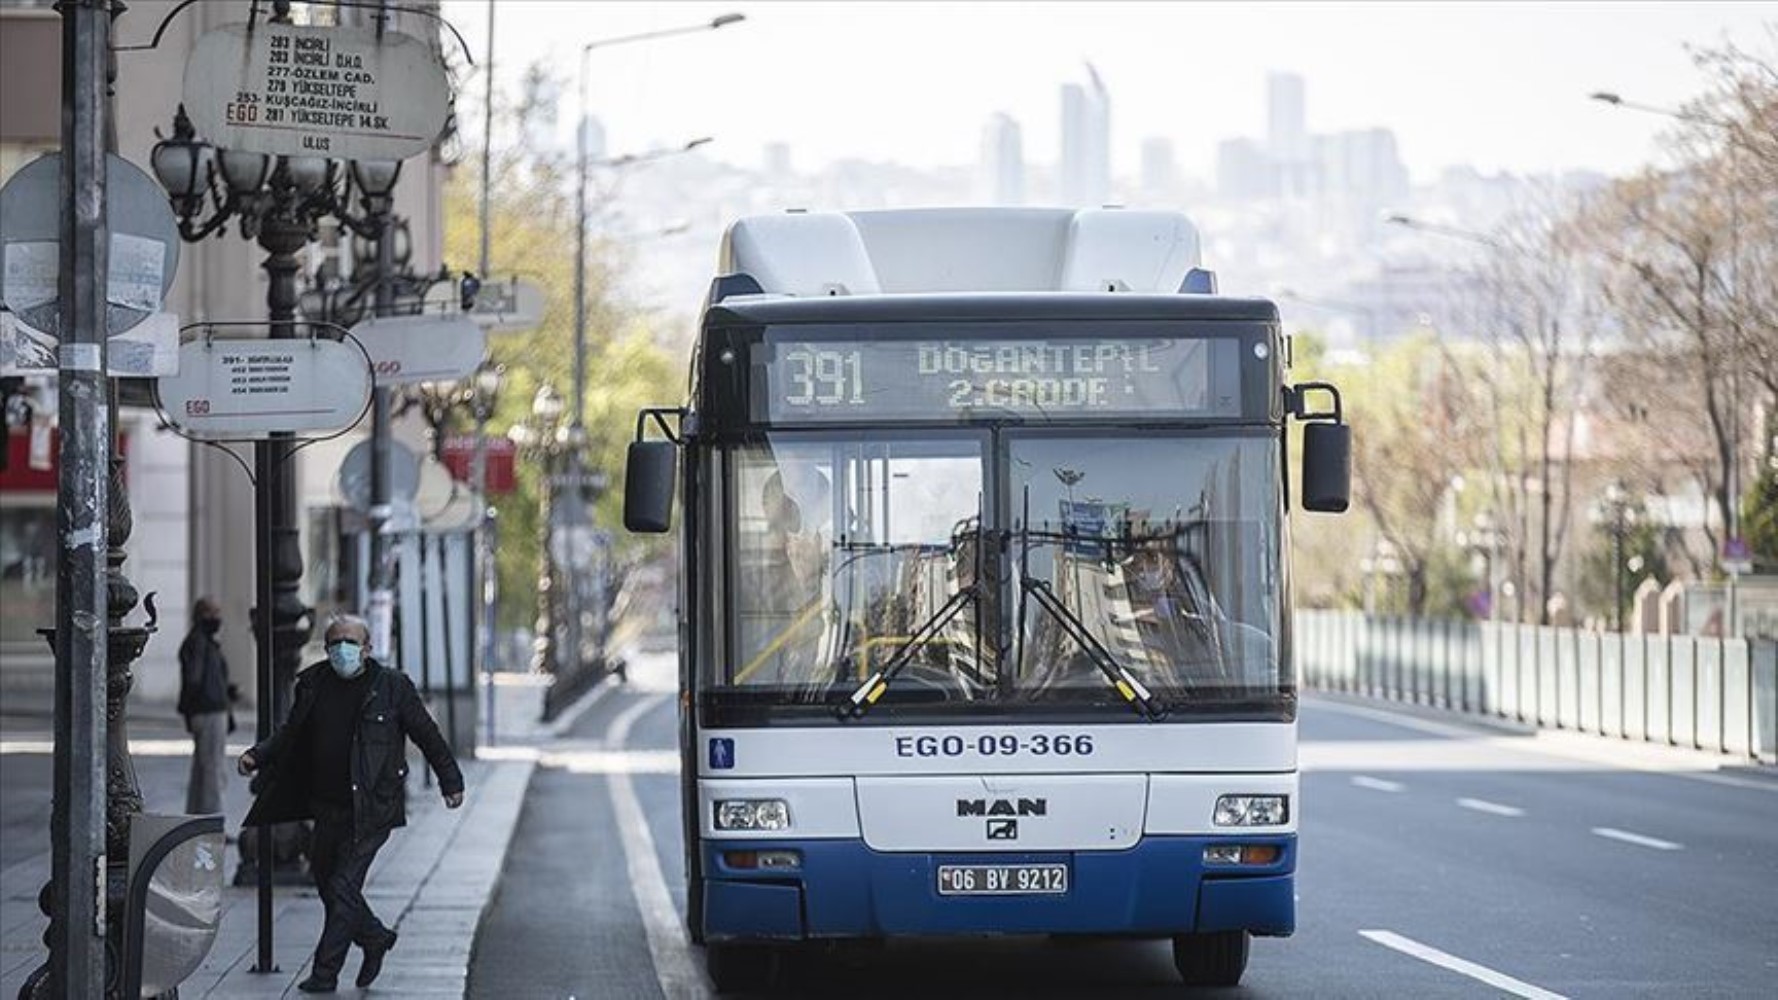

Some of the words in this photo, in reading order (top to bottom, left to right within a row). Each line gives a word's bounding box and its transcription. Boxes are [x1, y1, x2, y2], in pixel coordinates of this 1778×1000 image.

[344, 72, 375, 84] CAD.
[292, 79, 356, 98] YÜKSELTEPE
[226, 103, 258, 122] EGO
[290, 108, 354, 127] YÜKSELTEPE
[303, 135, 330, 151] ULUS
[786, 351, 865, 405] 391
[185, 399, 211, 414] EGO
[895, 734, 1095, 758] EGO-09-366
[956, 798, 1047, 817] MAN
[952, 868, 975, 890] 06
[1017, 867, 1063, 890] 9212
